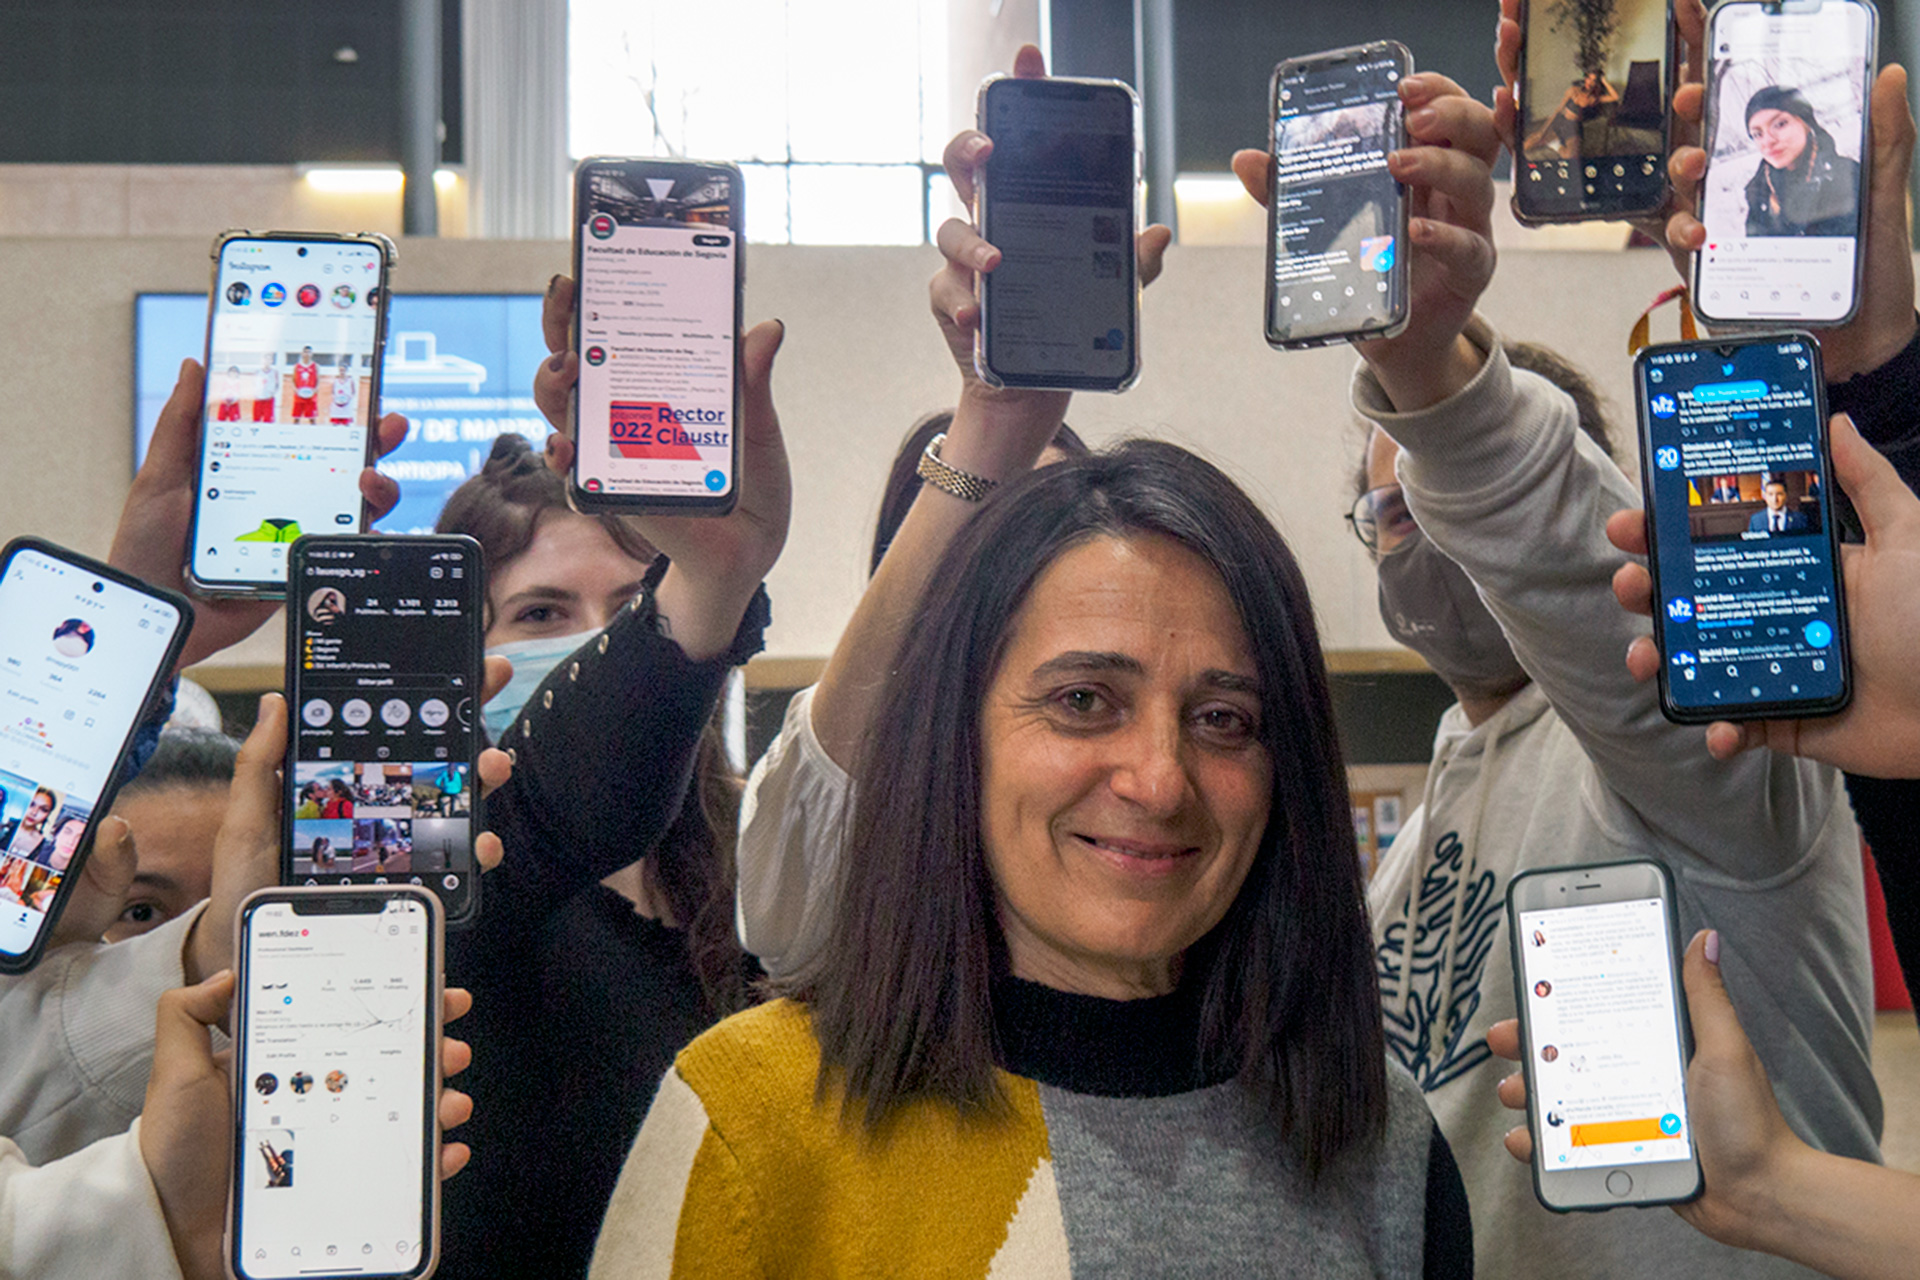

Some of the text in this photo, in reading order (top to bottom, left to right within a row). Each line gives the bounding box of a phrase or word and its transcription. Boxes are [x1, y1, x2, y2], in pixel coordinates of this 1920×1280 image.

[588, 246, 727, 260] Facultad de Educación de Segovia
[228, 261, 272, 274] Instagram
[658, 406, 726, 423] Rector
[423, 417, 459, 443] DE
[612, 421, 652, 438] 022
[656, 427, 729, 445] Claustr
[1657, 447, 1678, 463] 20
[258, 928, 299, 939] wen.fdez
